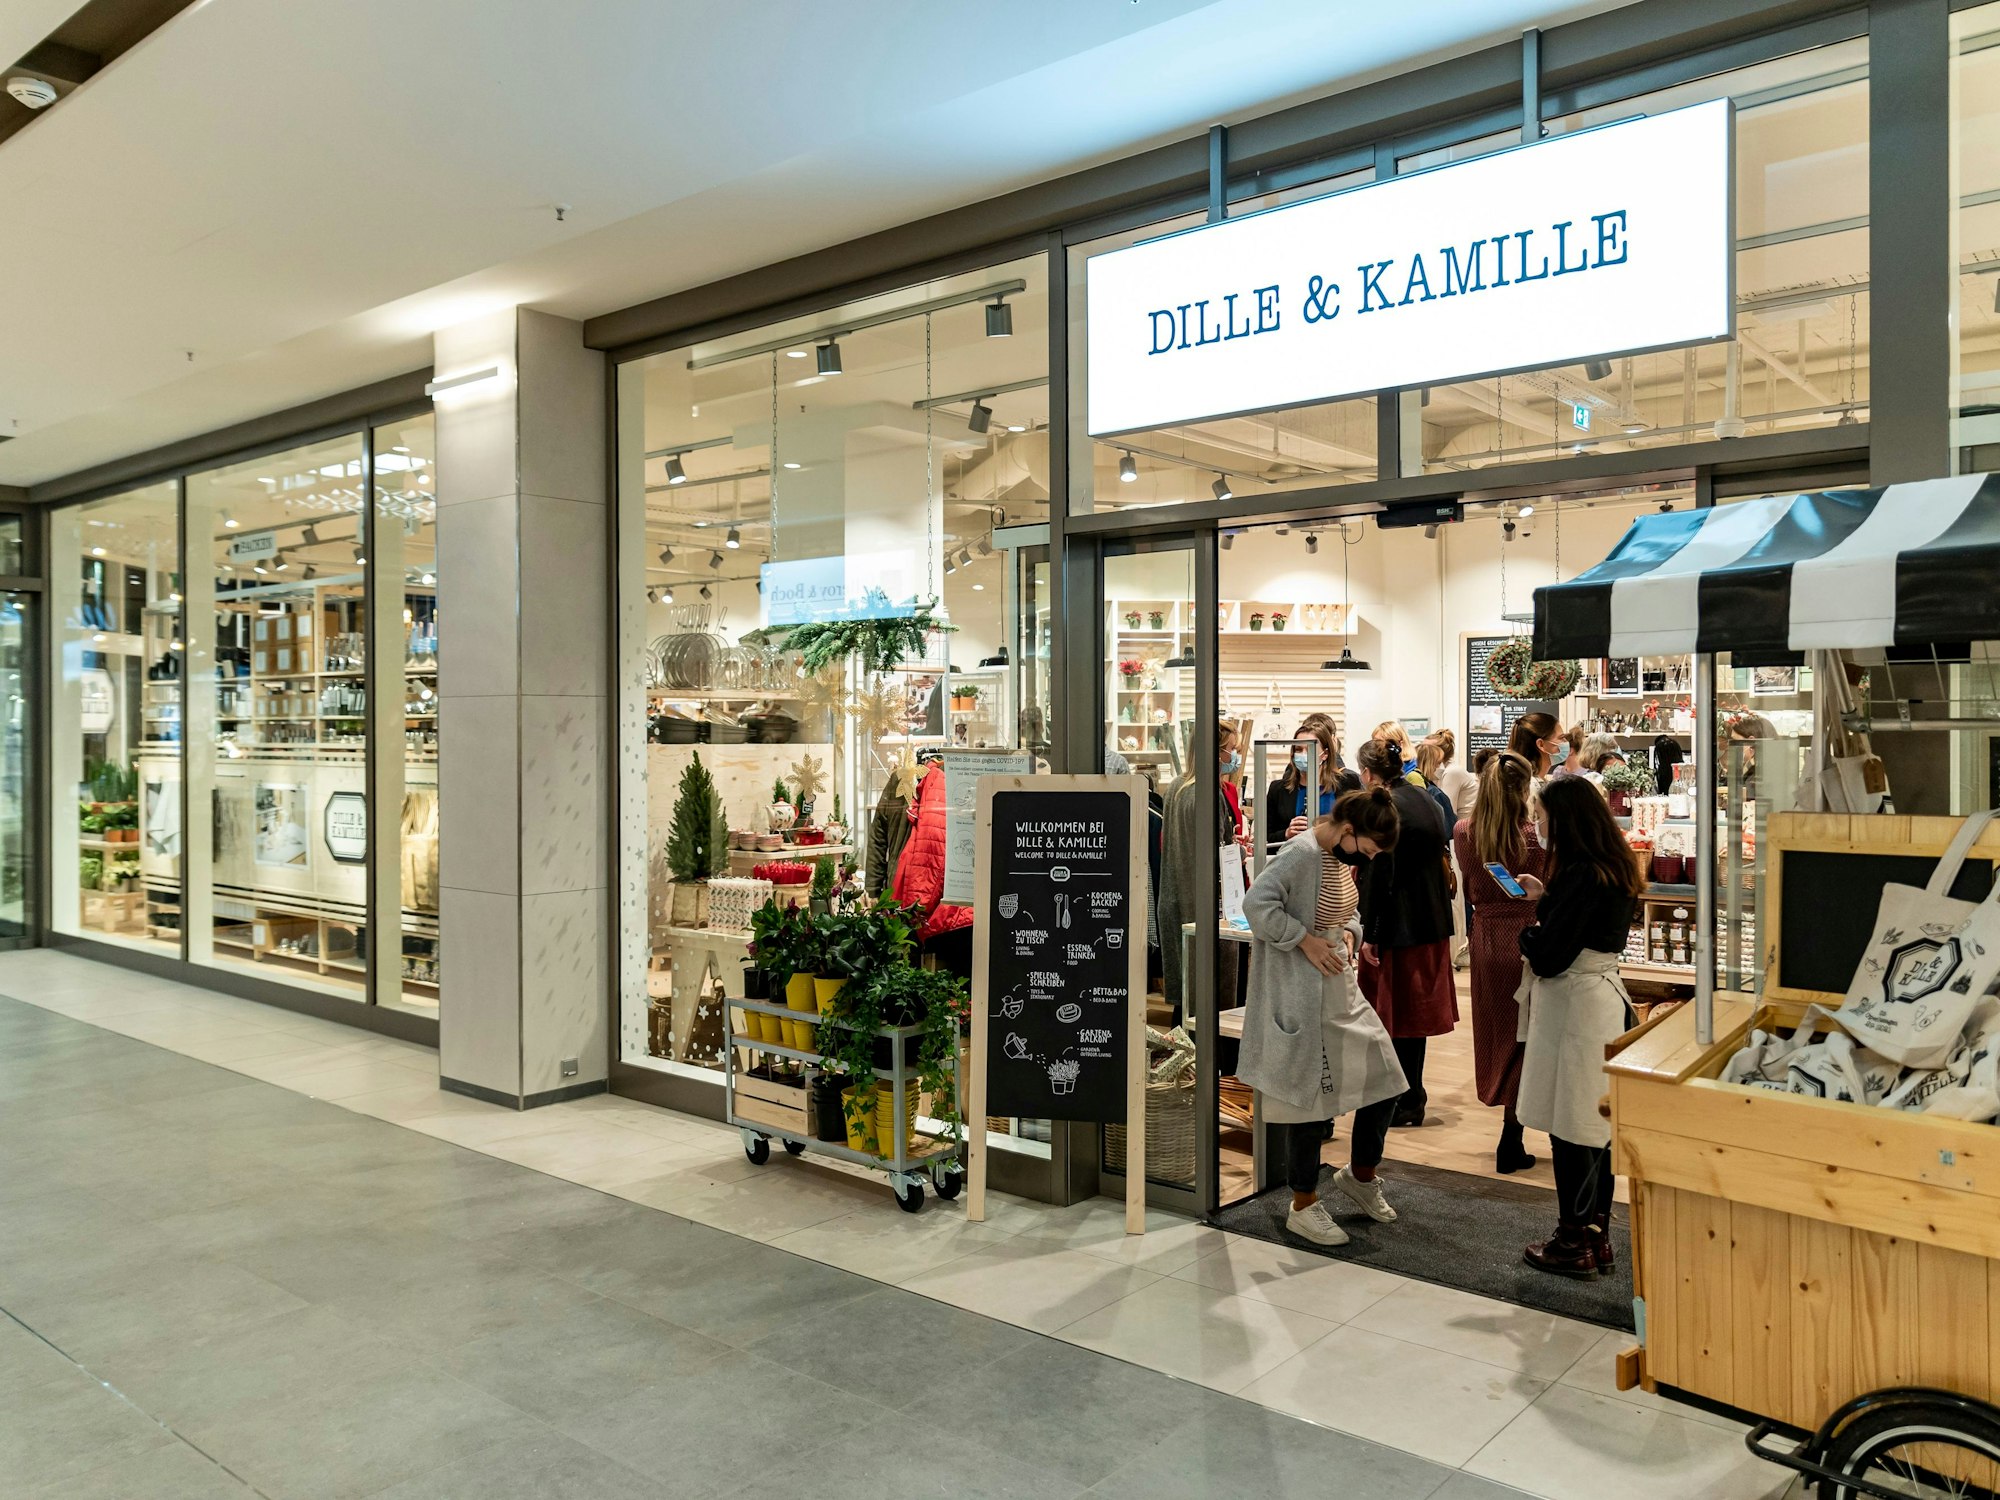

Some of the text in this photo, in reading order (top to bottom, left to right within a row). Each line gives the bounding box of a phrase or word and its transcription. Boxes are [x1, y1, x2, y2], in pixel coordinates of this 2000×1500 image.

[1148, 209, 1629, 356] DILLE & KAMILLE
[1016, 822, 1104, 833] WILLKOMMEN BEI
[1017, 835, 1107, 848] DILLE & KAMILLE!
